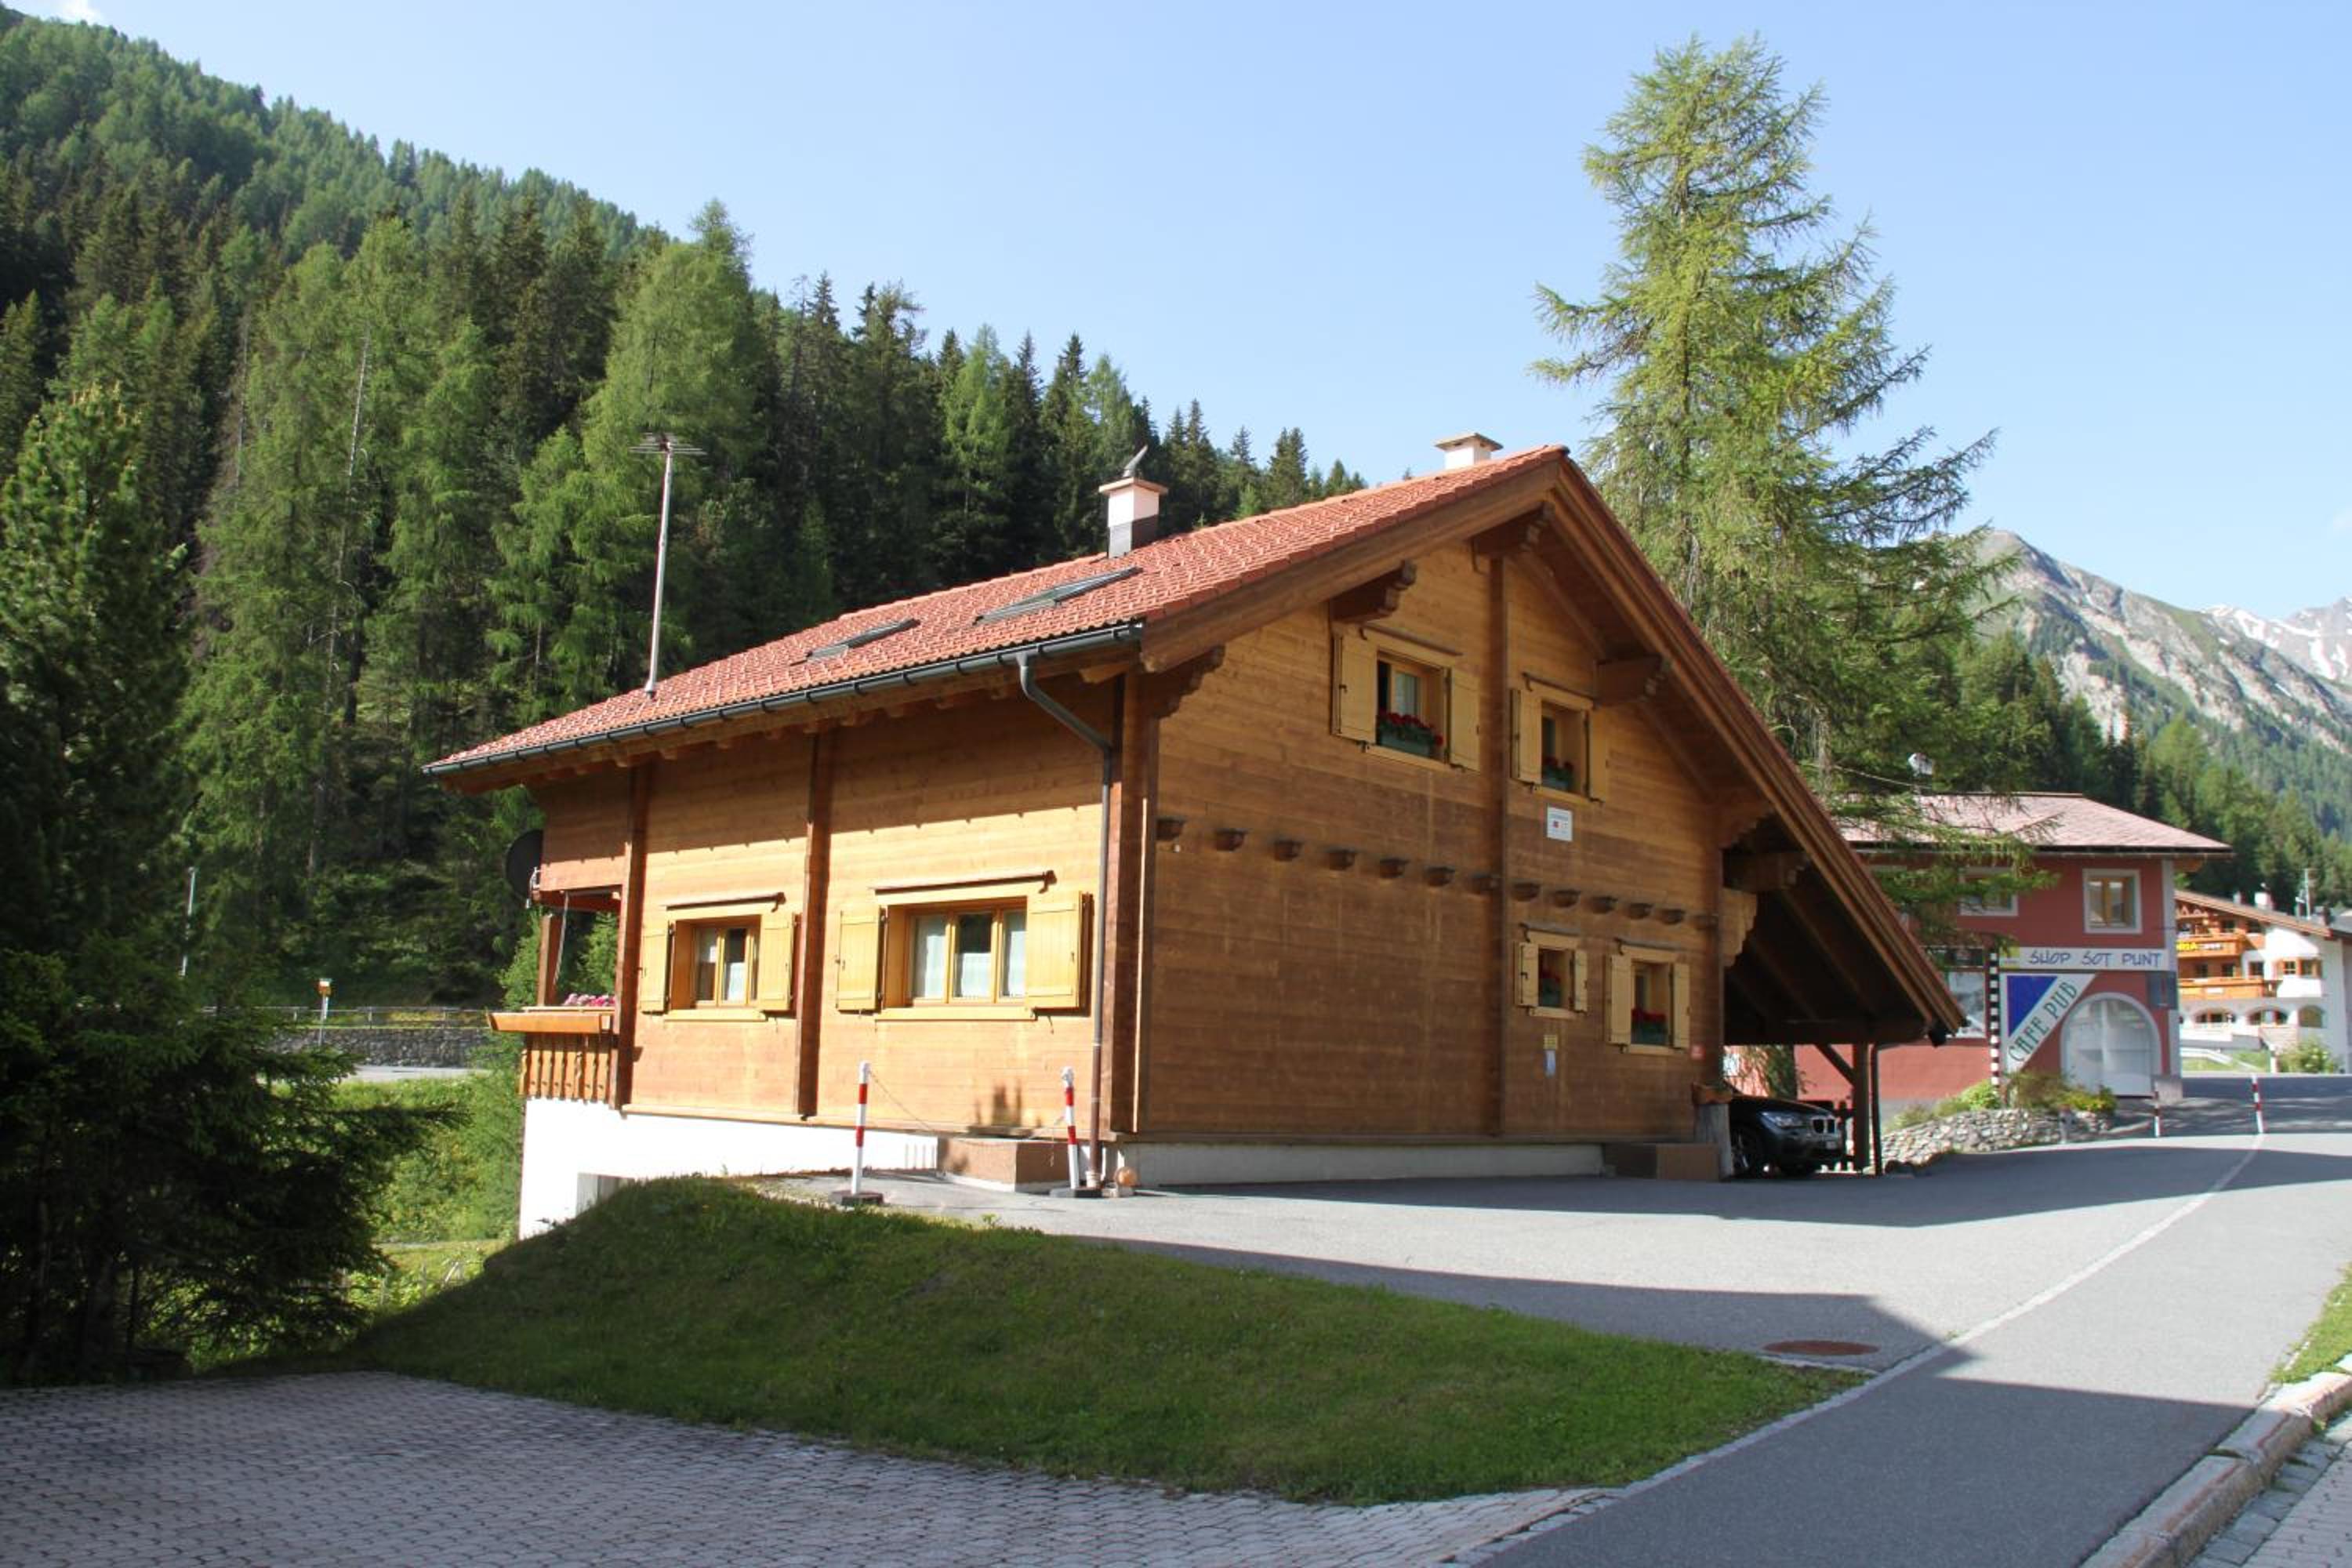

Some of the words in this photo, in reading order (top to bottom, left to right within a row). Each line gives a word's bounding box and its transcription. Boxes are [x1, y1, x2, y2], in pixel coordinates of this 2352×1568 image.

[2028, 950, 2071, 964] SHOP
[2082, 951, 2113, 966] SOT
[2122, 952, 2162, 966] PUNT
[2009, 1016, 2049, 1062] CAFE
[2044, 982, 2078, 1019] PUB
